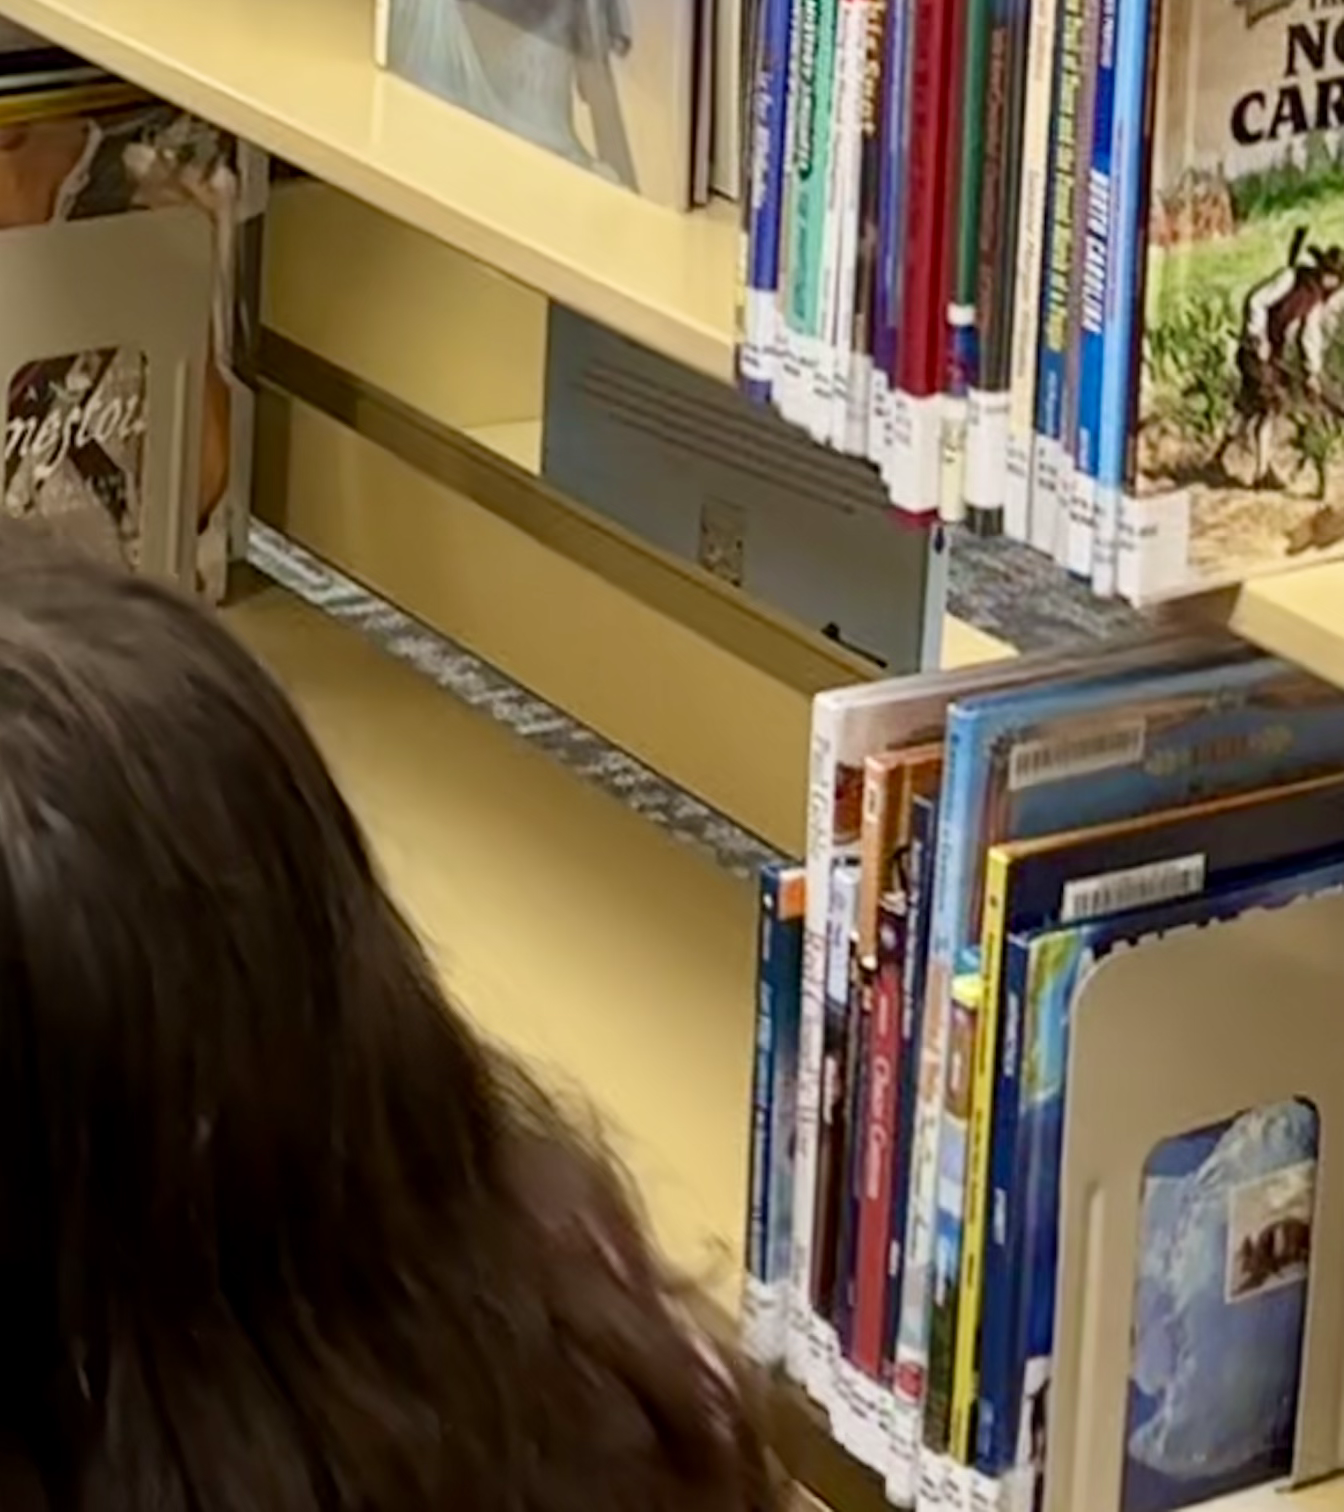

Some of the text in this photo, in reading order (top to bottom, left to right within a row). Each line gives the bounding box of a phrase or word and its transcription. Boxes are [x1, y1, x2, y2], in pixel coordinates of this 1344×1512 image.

[859, 59, 883, 140] Spot
[1080, 168, 1111, 336] NORTH CAROLINA
